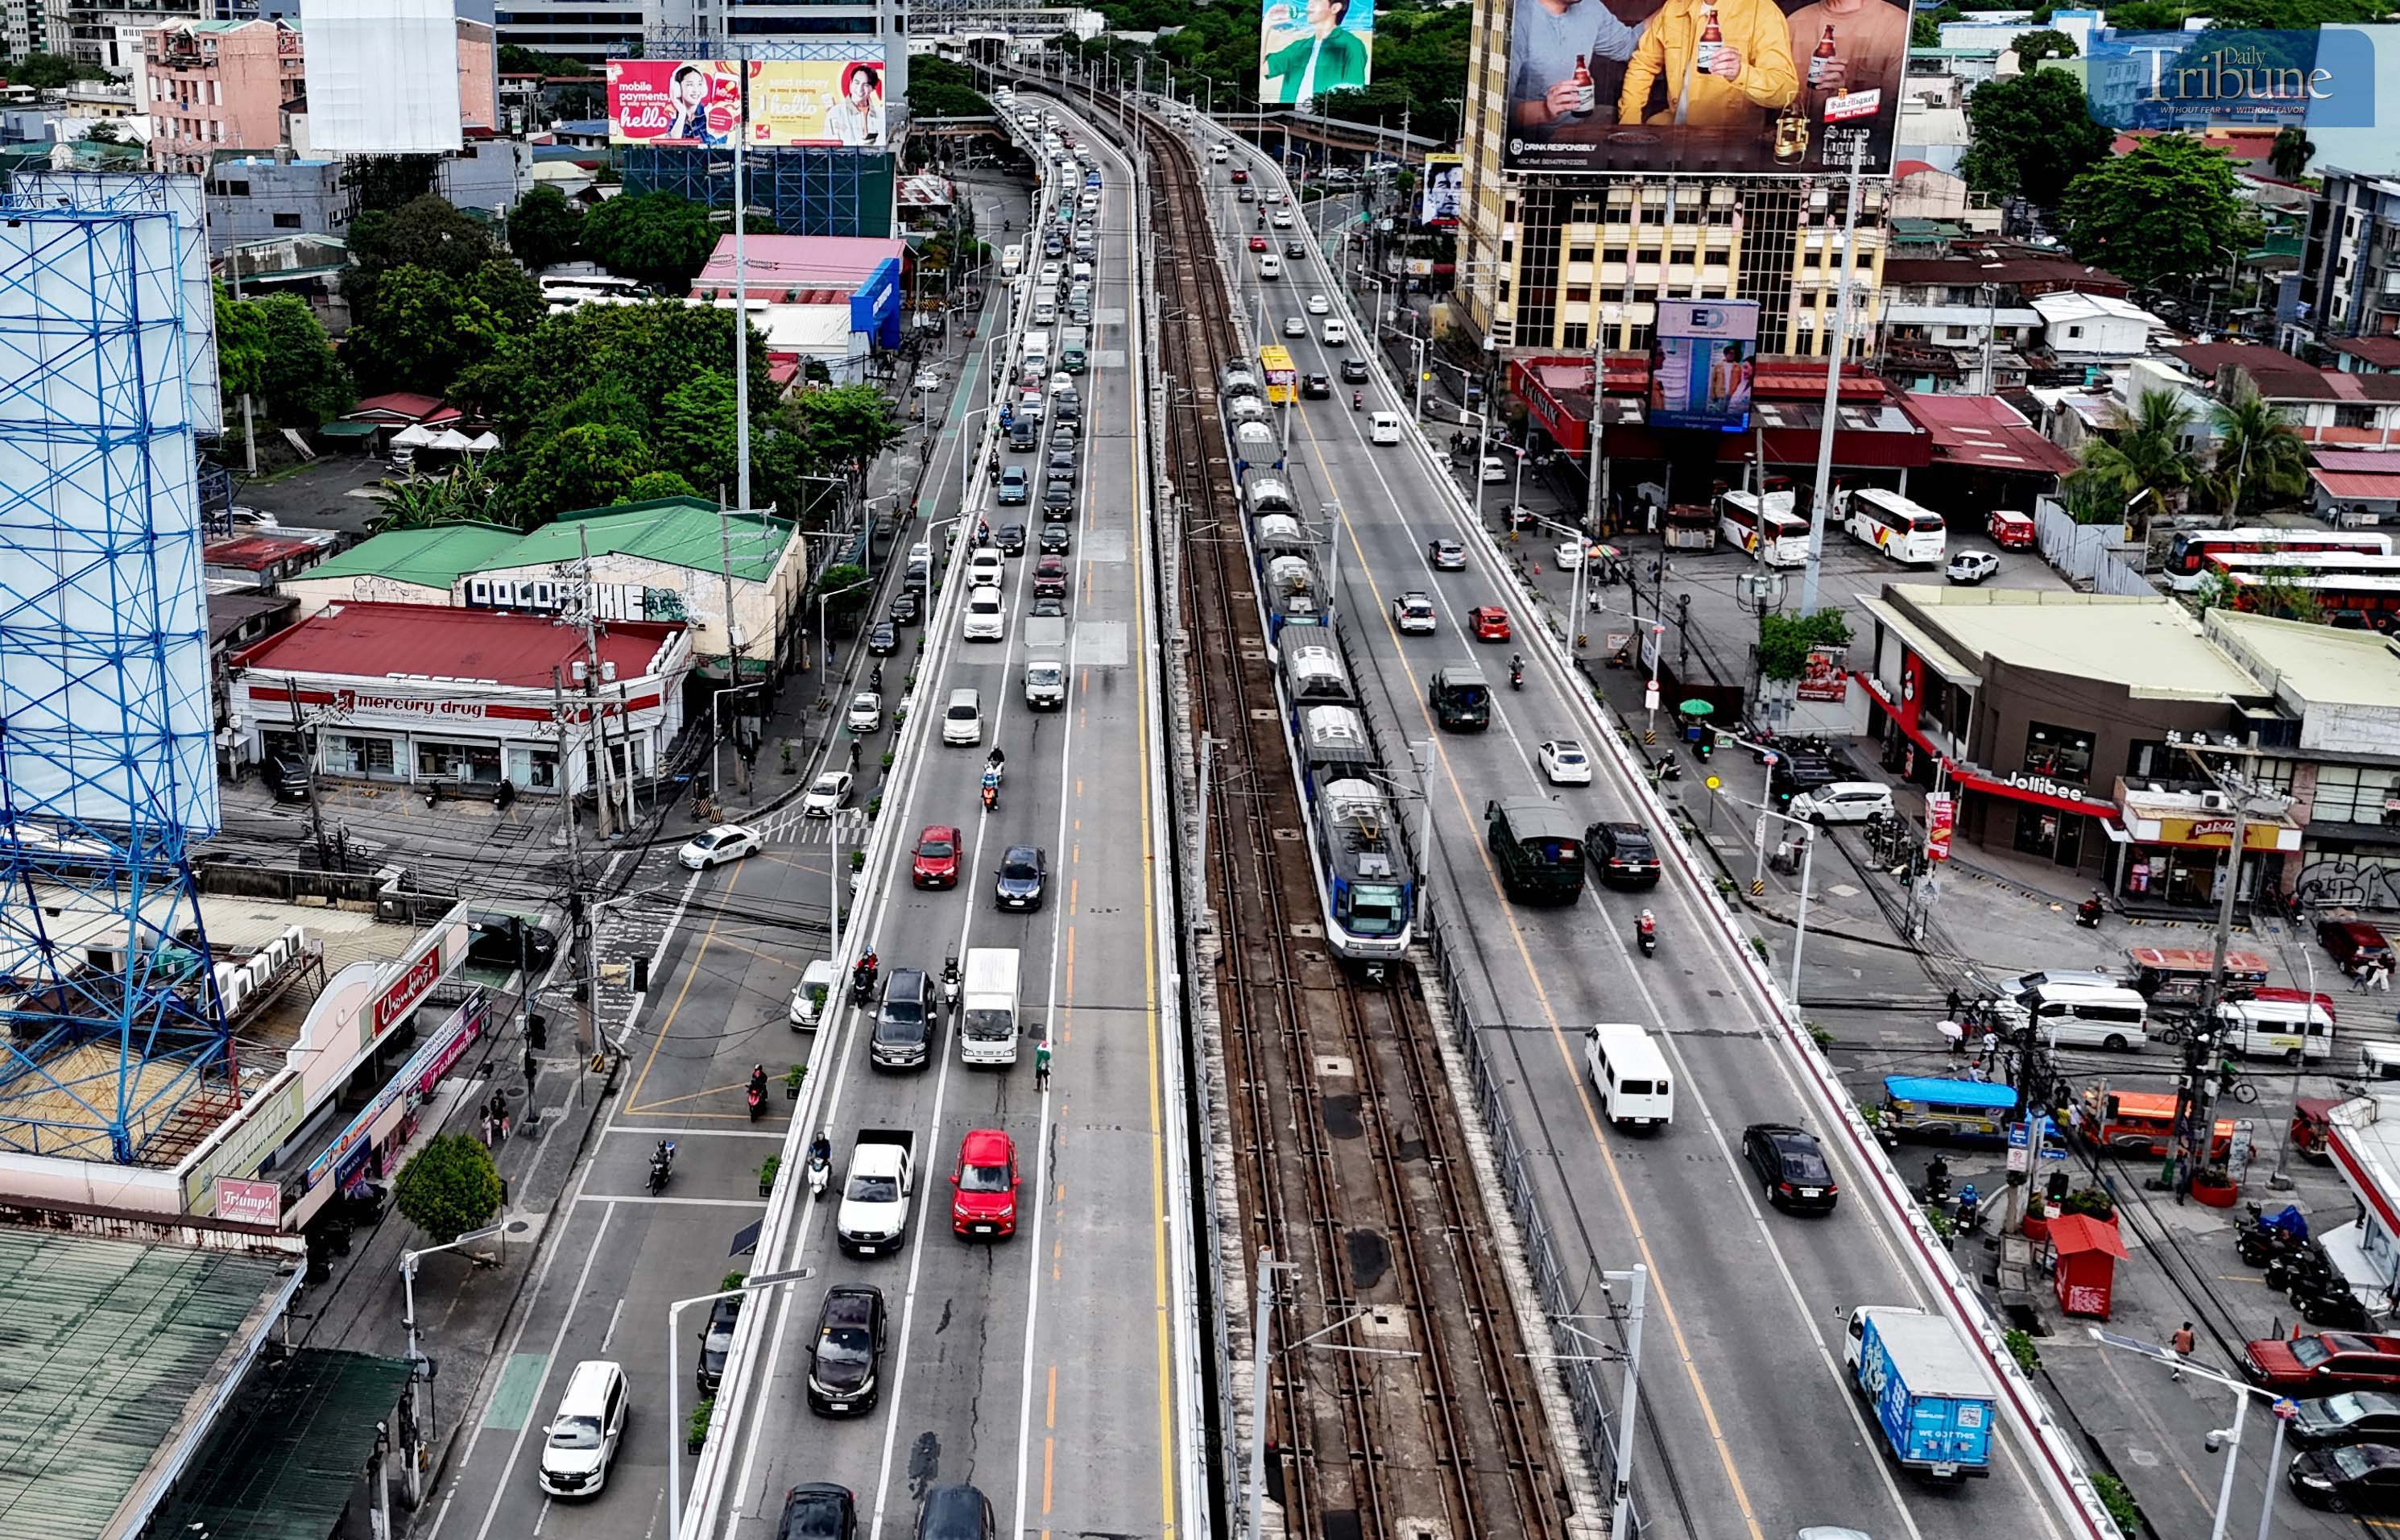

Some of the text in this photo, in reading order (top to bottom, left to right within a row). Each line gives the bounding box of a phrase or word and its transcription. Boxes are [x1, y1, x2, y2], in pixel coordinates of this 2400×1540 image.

[619, 82, 652, 91] mobile
[769, 77, 830, 89] send money
[619, 93, 671, 102] payments,
[770, 94, 817, 115] hello
[620, 107, 668, 127] hello
[1546, 143, 1597, 151] RESPONSIBLY
[358, 695, 482, 718] mercury drug
[2003, 771, 2082, 801] Jollibee
[381, 965, 432, 1025] Chowking
[223, 1190, 272, 1210] Triumph
[1934, 1430, 1954, 1439] GOT
